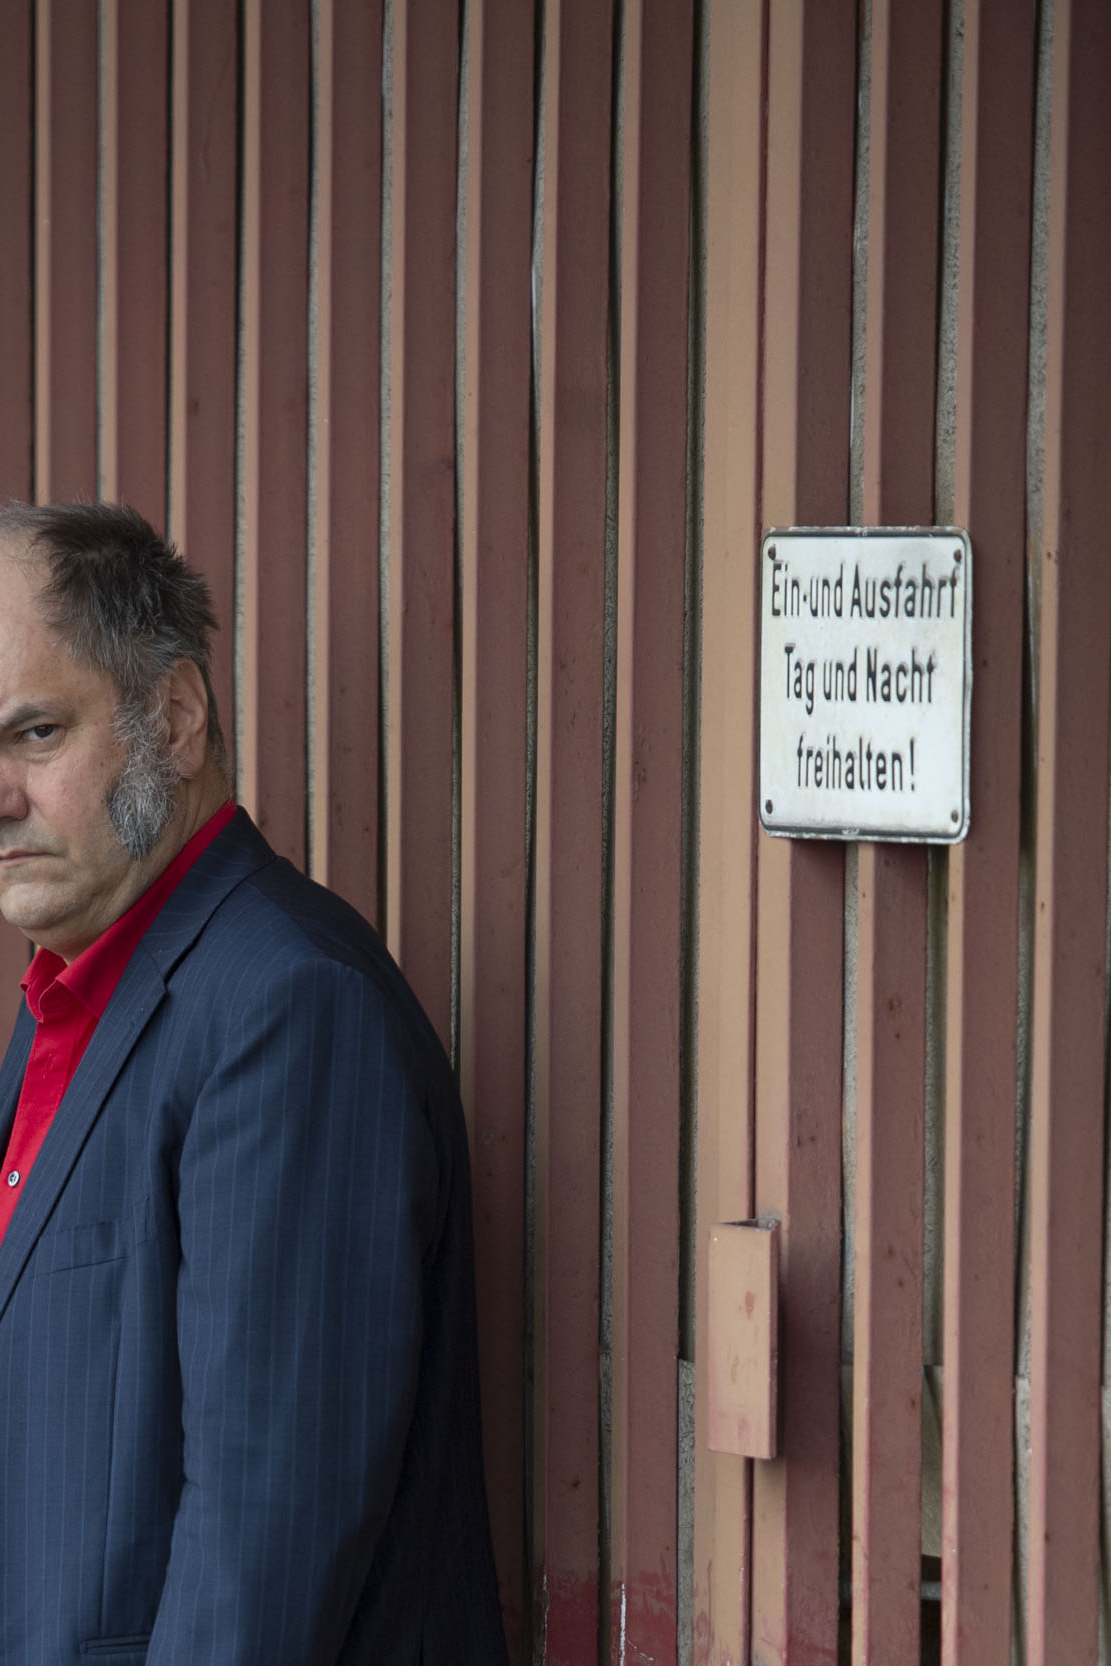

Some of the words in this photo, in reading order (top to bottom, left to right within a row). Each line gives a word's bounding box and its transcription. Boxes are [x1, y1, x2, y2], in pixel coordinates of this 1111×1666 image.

[850, 563, 958, 618] Ausfahrt
[784, 642, 816, 715] Tag
[823, 647, 858, 702] und
[866, 646, 936, 703] Nacht
